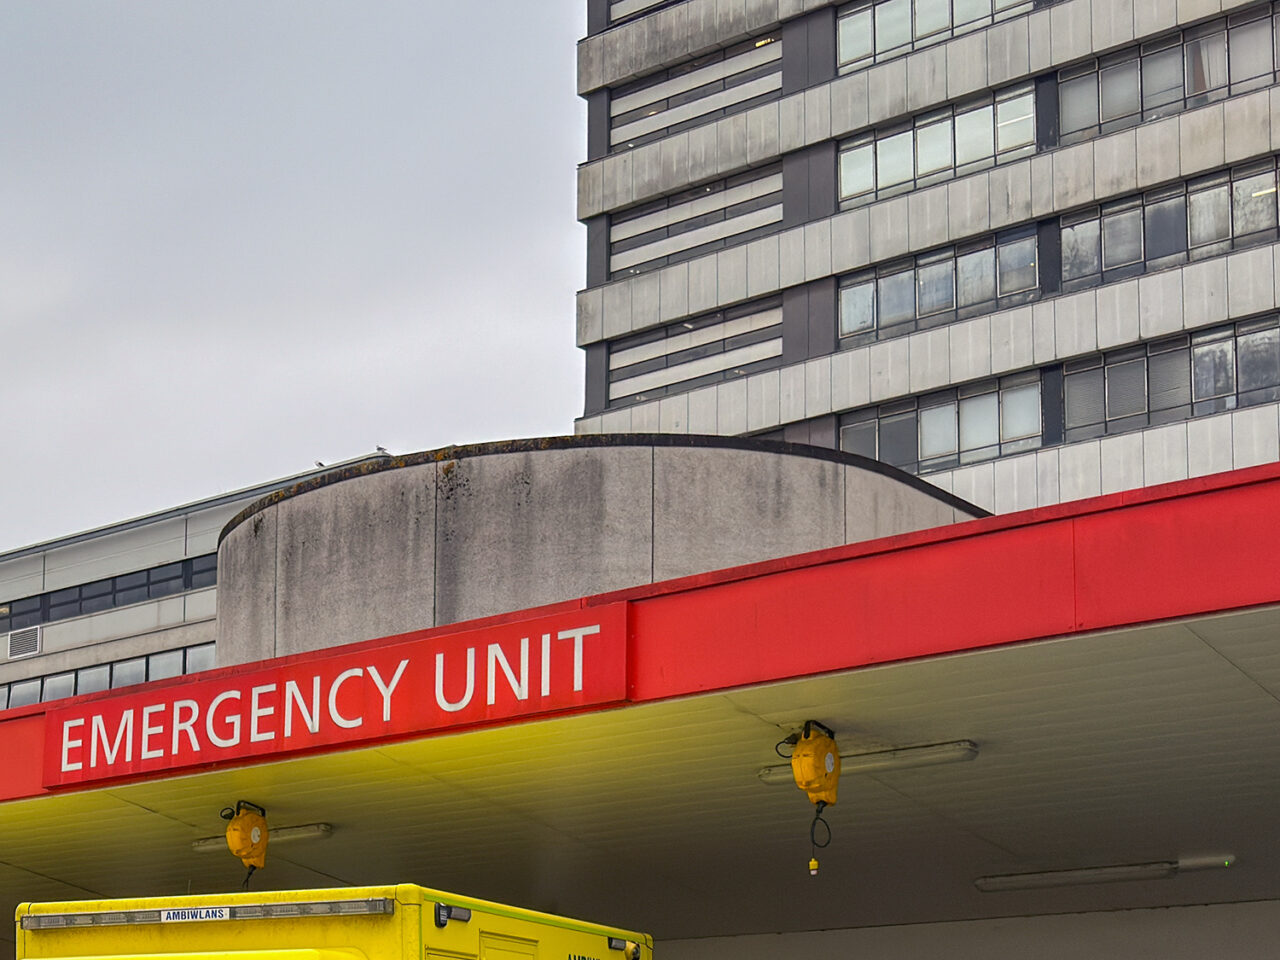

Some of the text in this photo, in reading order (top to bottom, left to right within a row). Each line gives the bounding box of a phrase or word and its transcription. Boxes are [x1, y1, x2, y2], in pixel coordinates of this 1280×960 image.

[61, 624, 600, 773] EMERGENCY UNIT
[165, 908, 225, 921] AMBIWLANS
